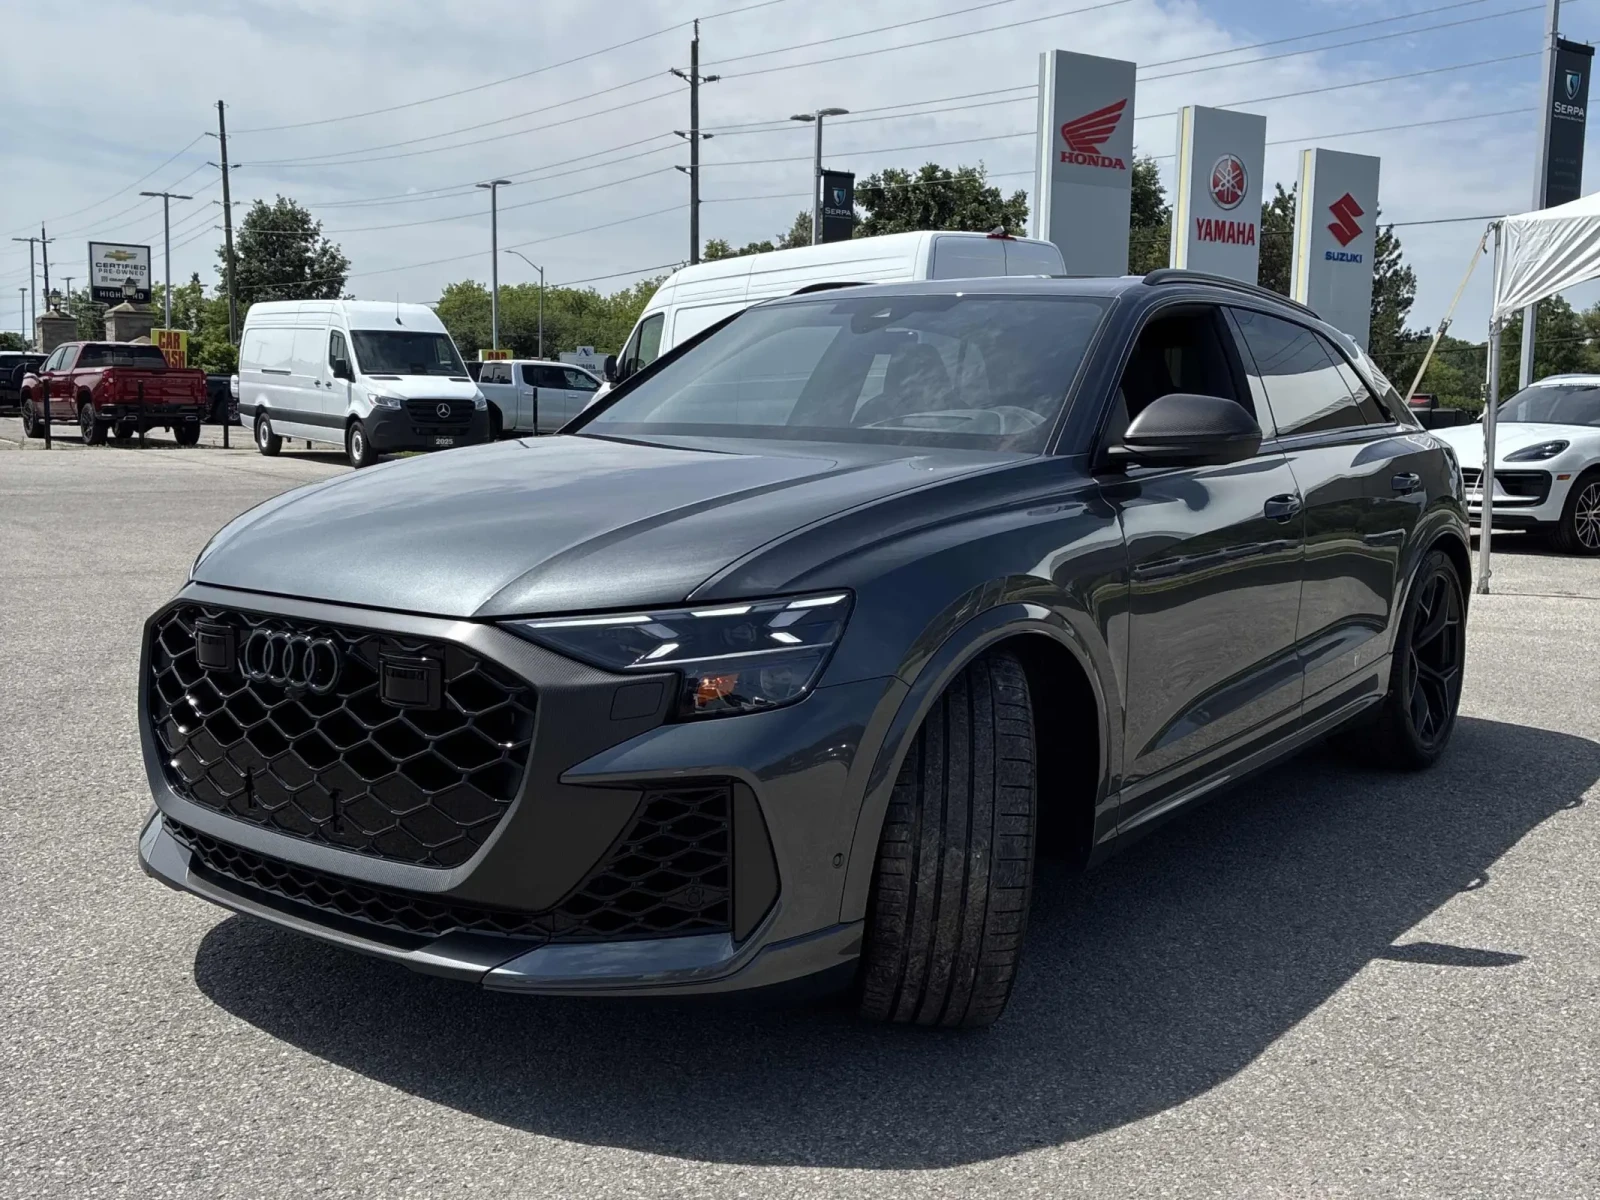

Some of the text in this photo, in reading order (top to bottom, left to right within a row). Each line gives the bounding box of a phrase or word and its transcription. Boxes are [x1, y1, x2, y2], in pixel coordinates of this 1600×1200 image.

[1554, 101, 1585, 117] SERPA
[1060, 151, 1126, 170] HONDA
[824, 206, 852, 216] SERPA
[1196, 217, 1256, 246] YAMAHA
[1325, 251, 1363, 264] SUZUKI
[95, 262, 147, 271] CERTIFIED
[98, 268, 145, 276] PRE-OWNED
[158, 331, 180, 350] CAR
